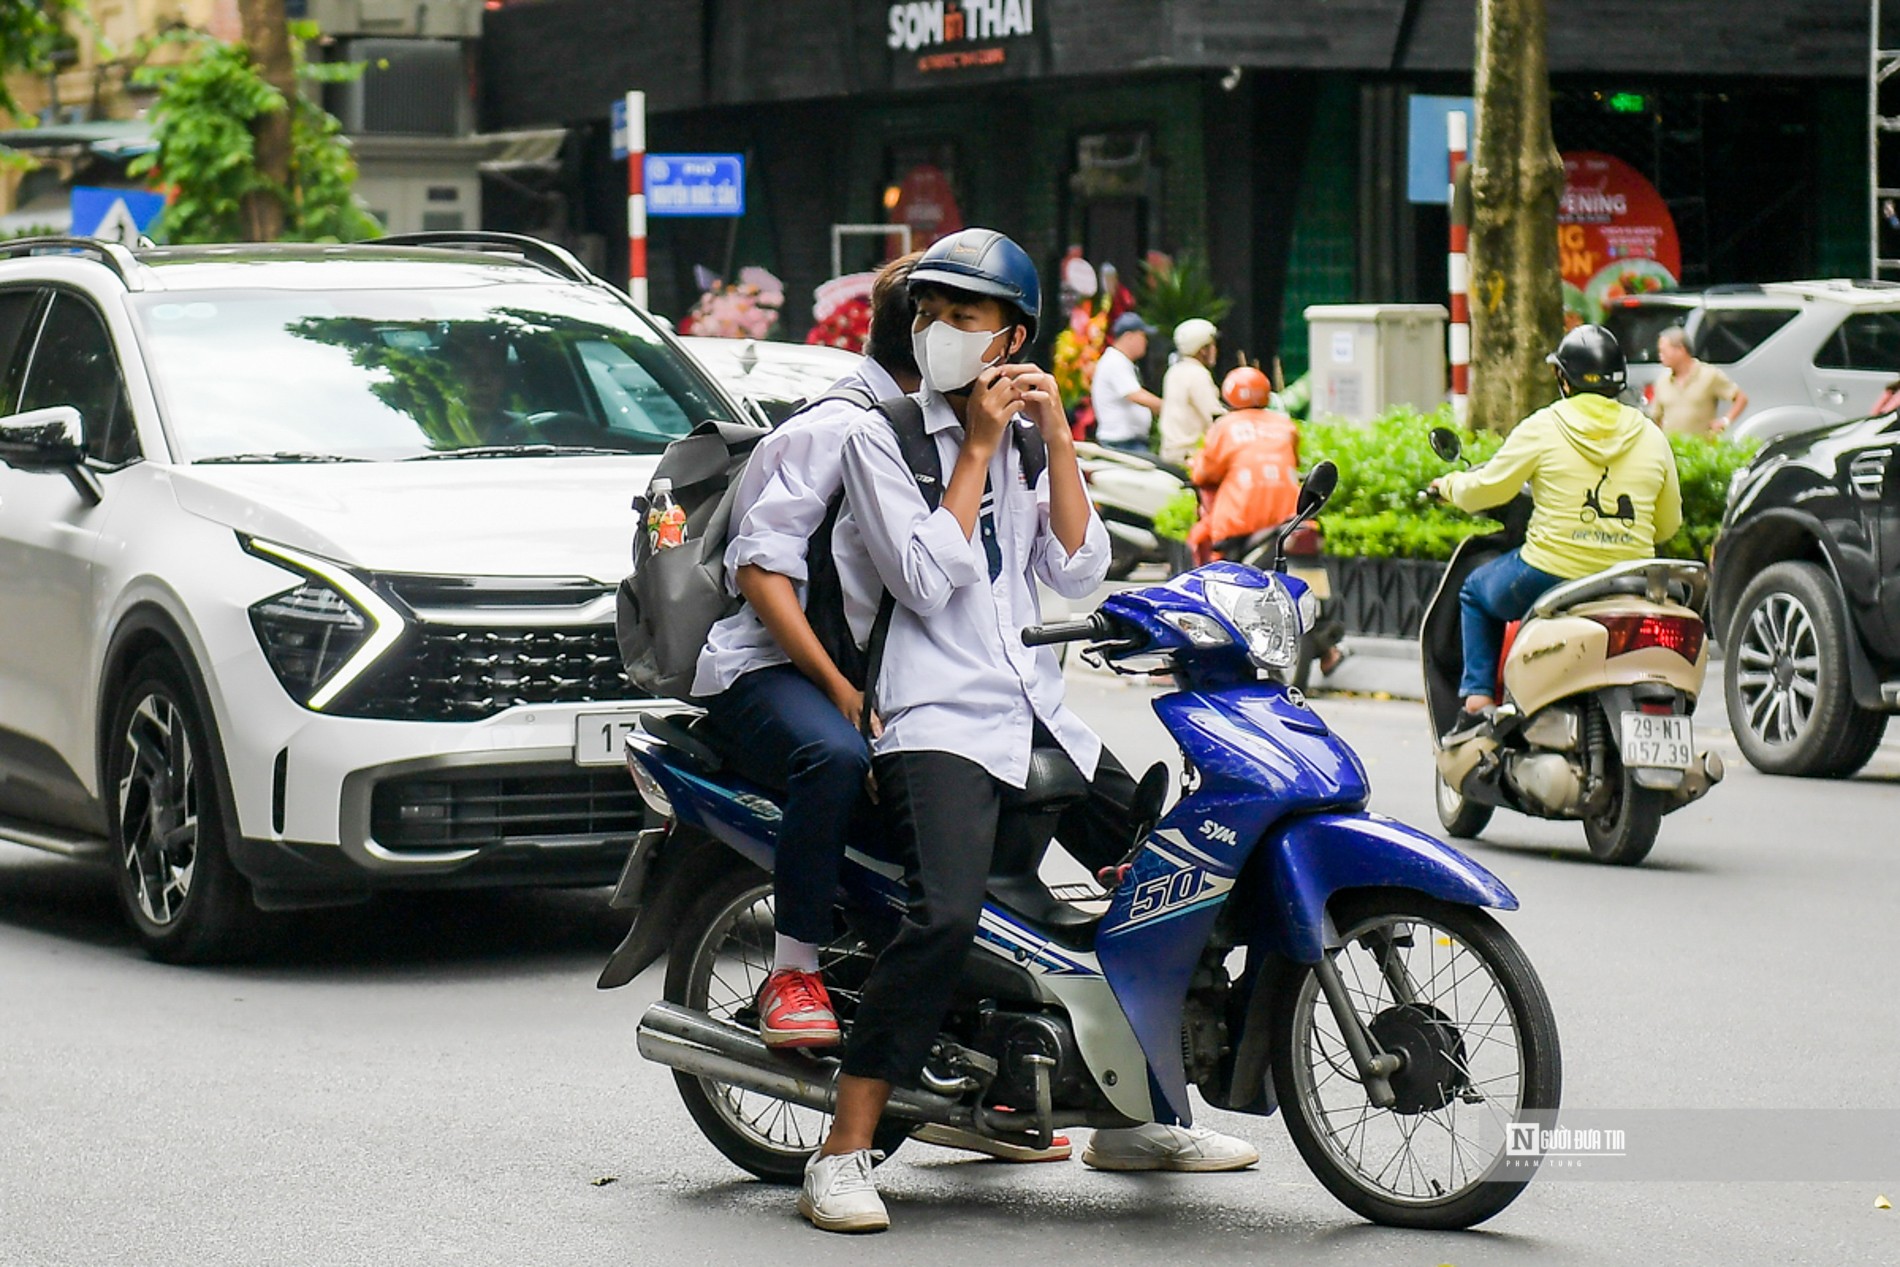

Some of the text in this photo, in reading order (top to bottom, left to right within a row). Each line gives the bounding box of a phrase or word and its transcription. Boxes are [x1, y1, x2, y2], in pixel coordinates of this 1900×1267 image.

[1633, 717, 1682, 741] 29-N1
[1627, 741, 1689, 765] 057.39
[1198, 819, 1238, 847] SYM
[1129, 865, 1206, 920] 50
